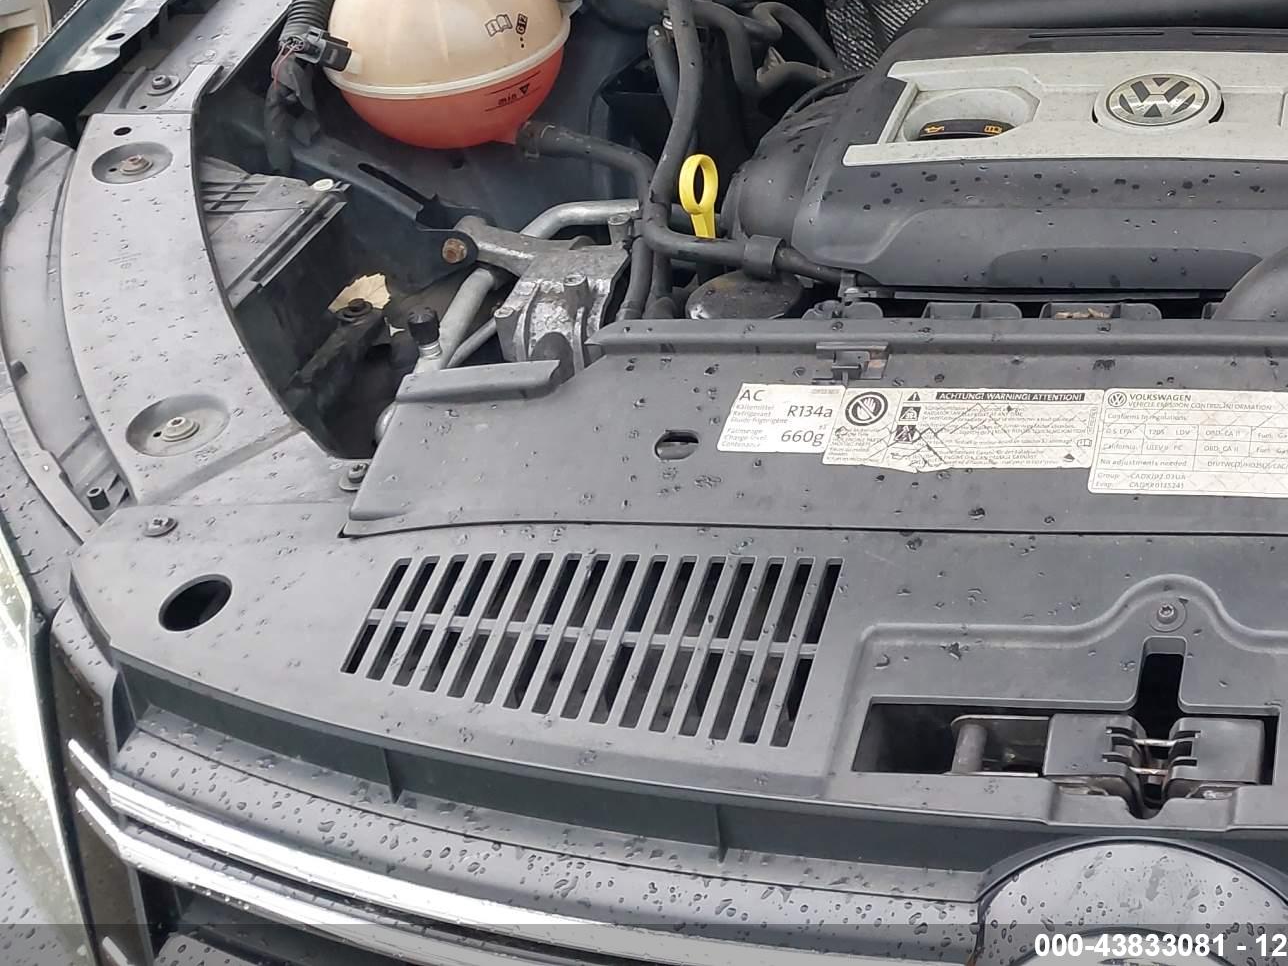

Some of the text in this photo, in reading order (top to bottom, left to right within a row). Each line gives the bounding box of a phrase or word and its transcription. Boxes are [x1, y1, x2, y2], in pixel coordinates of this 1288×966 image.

[739, 389, 766, 402] AC
[939, 393, 1083, 402] ACHTUNG! WARNING! ATTENTION!
[787, 405, 833, 418] R134a
[781, 430, 824, 447] 660g
